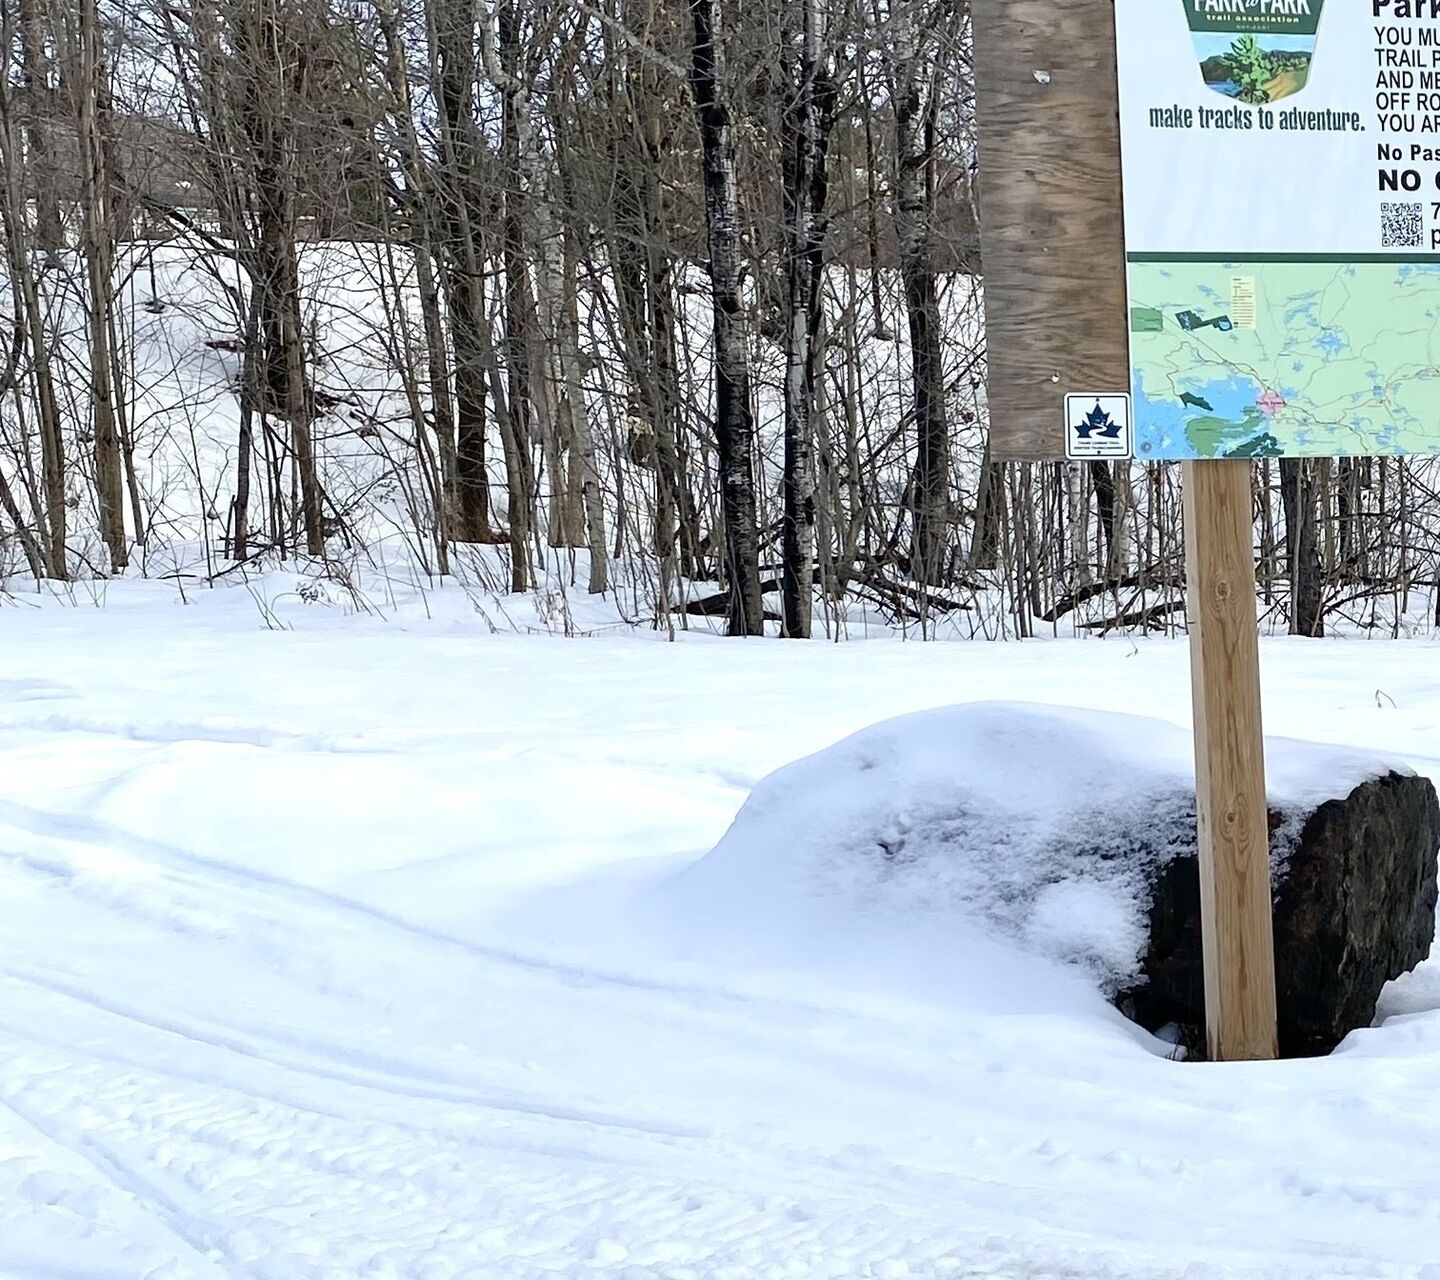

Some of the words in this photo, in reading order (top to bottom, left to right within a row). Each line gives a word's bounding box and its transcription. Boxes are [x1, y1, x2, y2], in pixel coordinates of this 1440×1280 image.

[1374, 27, 1411, 45] YOU
[1375, 49, 1427, 67] TRAIL
[1376, 71, 1413, 88] AND
[1376, 92, 1410, 110] OFF
[1150, 104, 1192, 128] make
[1198, 105, 1252, 129] tracks
[1258, 107, 1273, 129] to
[1280, 107, 1365, 131] adventure.
[1378, 114, 1414, 132] YOU
[1378, 144, 1402, 160] No
[1379, 169, 1421, 191] NO
